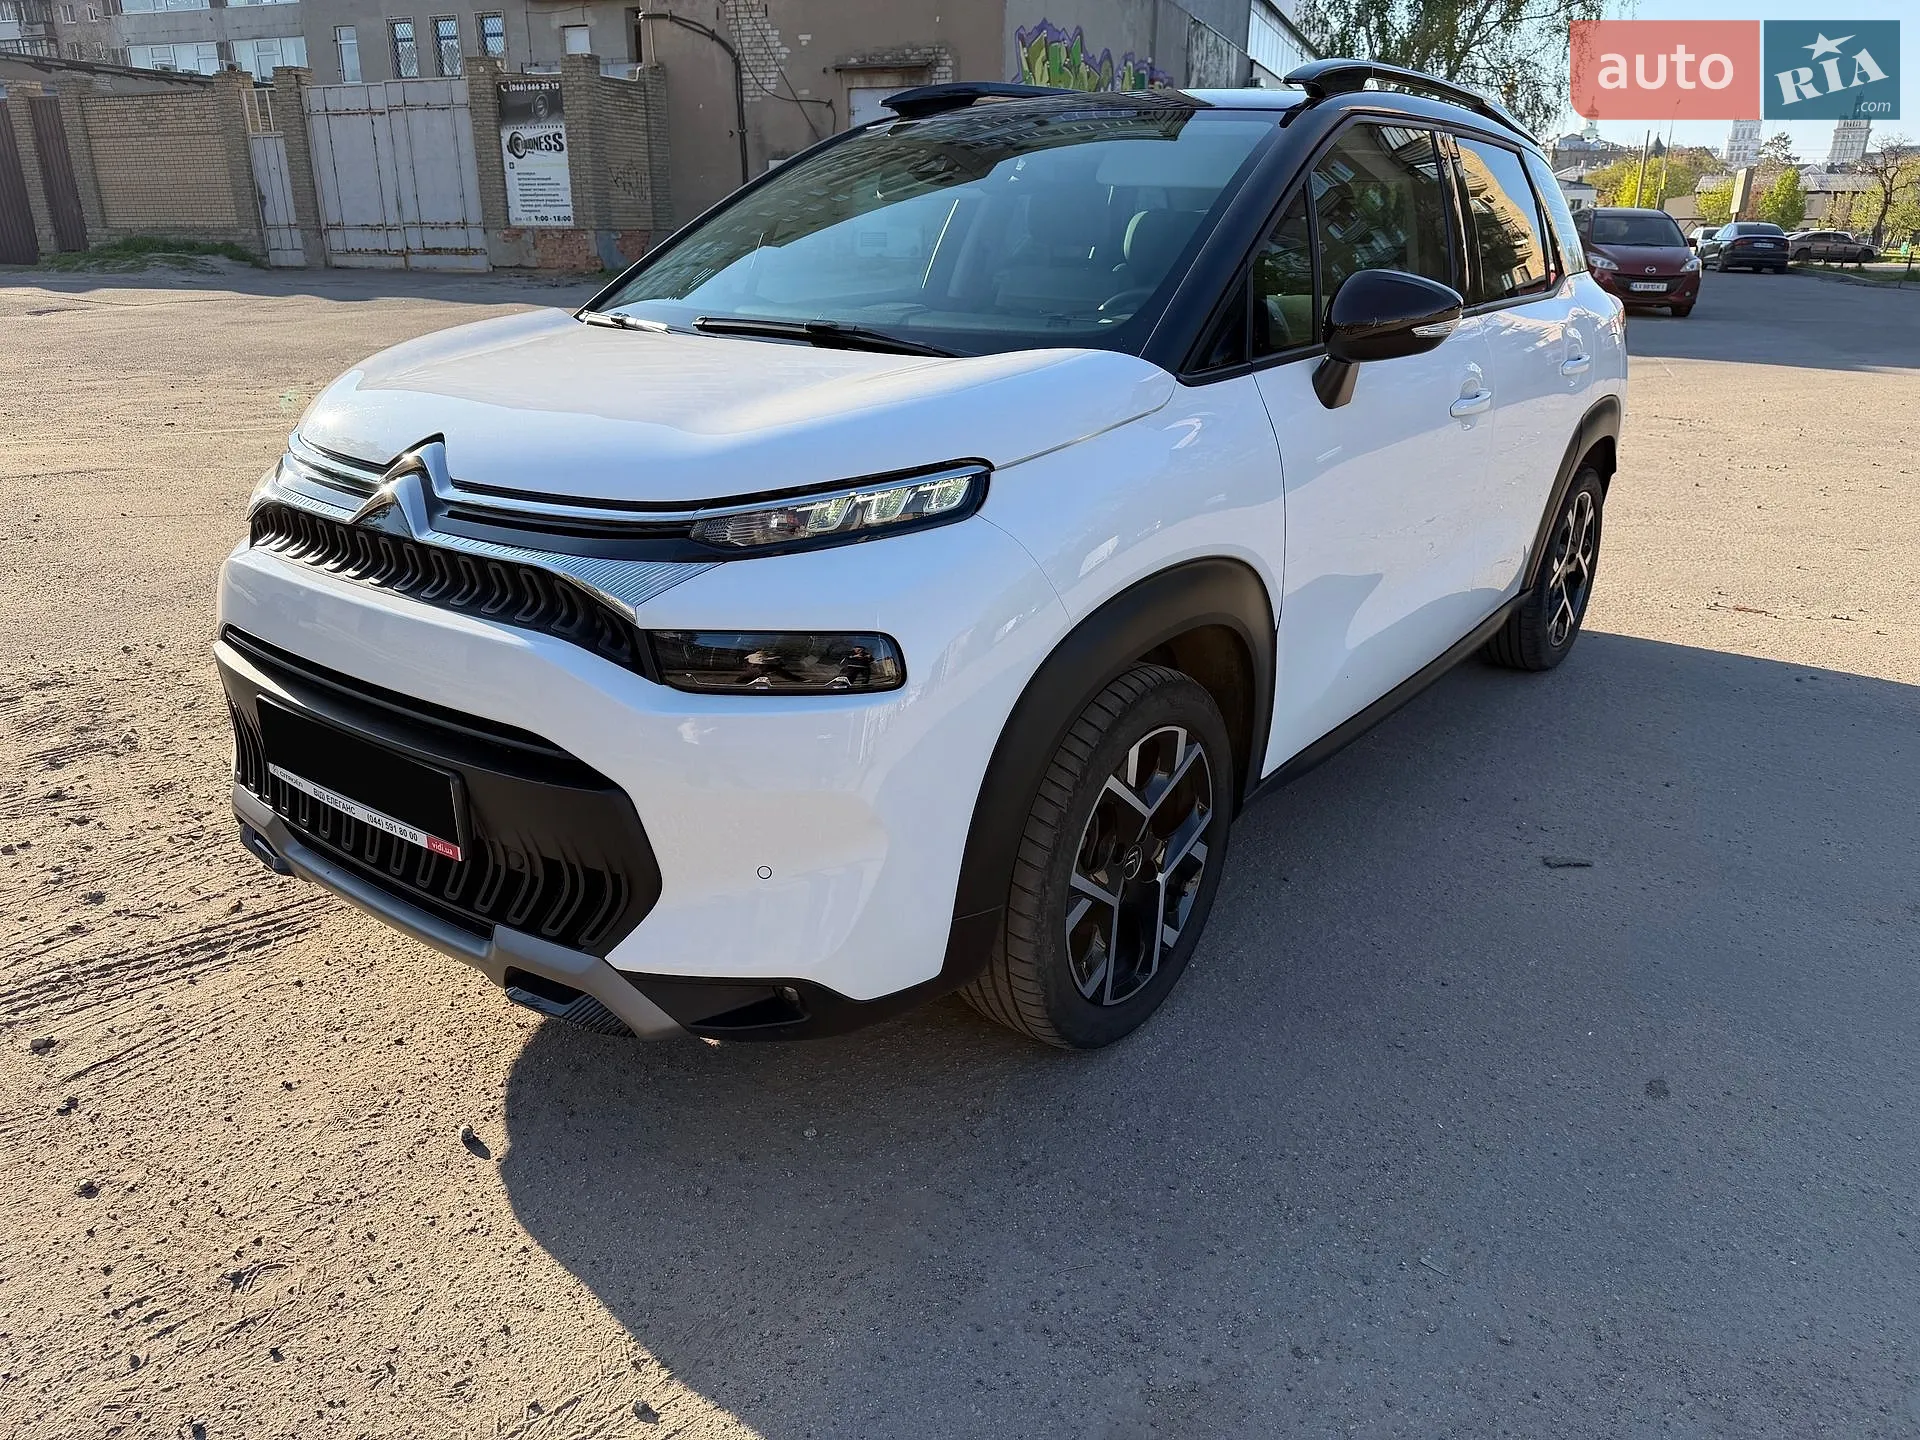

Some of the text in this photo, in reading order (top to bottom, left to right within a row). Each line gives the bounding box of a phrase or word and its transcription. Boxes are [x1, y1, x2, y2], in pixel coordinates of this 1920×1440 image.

[367, 813, 418, 842] (044) 591 80 00
[431, 840, 453, 856] vidi.ua
